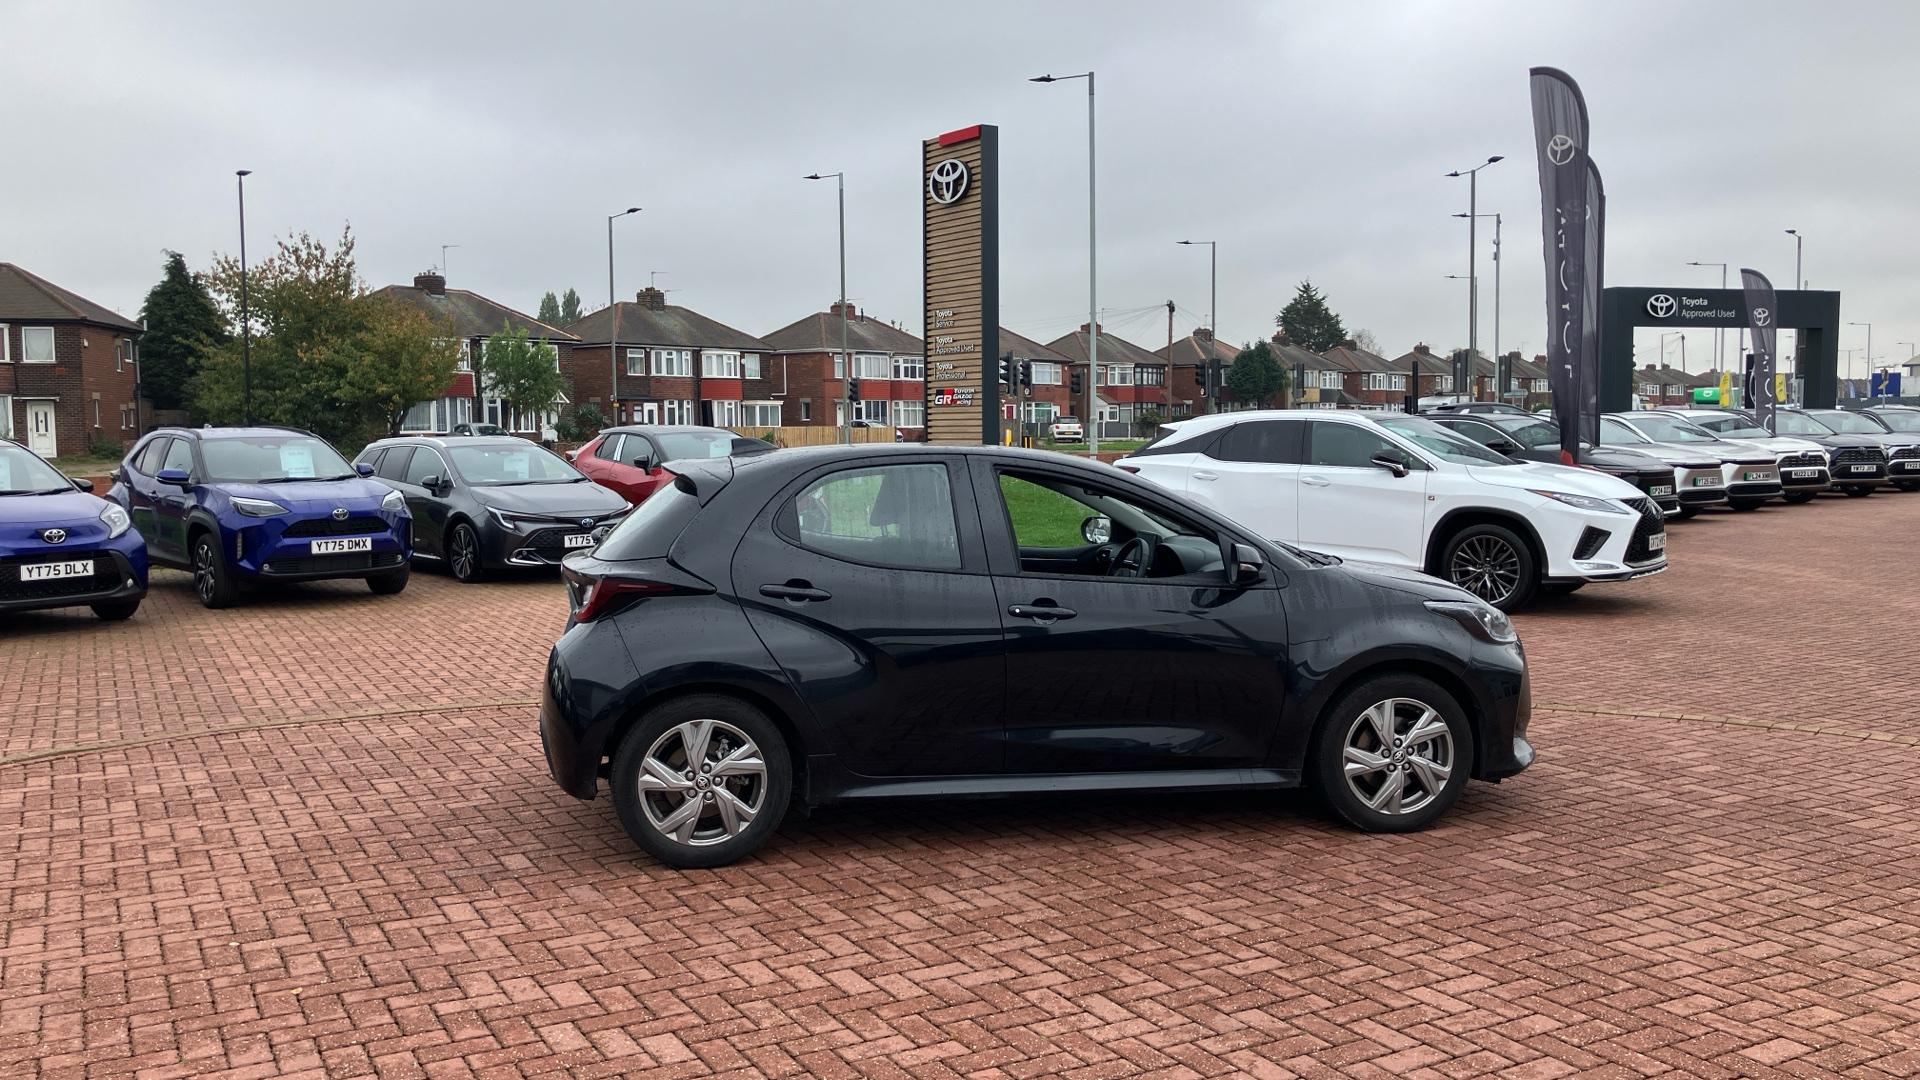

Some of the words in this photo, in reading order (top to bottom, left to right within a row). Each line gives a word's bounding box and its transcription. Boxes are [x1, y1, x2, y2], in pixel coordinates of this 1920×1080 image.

[1681, 296, 1708, 307] Toyota
[936, 310, 953, 319] Toyota
[1681, 309, 1716, 319] Approved
[1717, 309, 1736, 318] Used
[936, 320, 954, 328] Service
[936, 337, 953, 345] Toyota
[936, 345, 960, 355] Approved
[961, 344, 974, 352] Used
[936, 362, 953, 371] Toyota
[936, 371, 966, 380] Professional
[935, 395, 952, 405] GR
[316, 540, 345, 552] YT75
[347, 538, 368, 550] DMX
[568, 536, 590, 545] YT75
[26, 564, 61, 578] YT75
[64, 562, 89, 575] DLX
